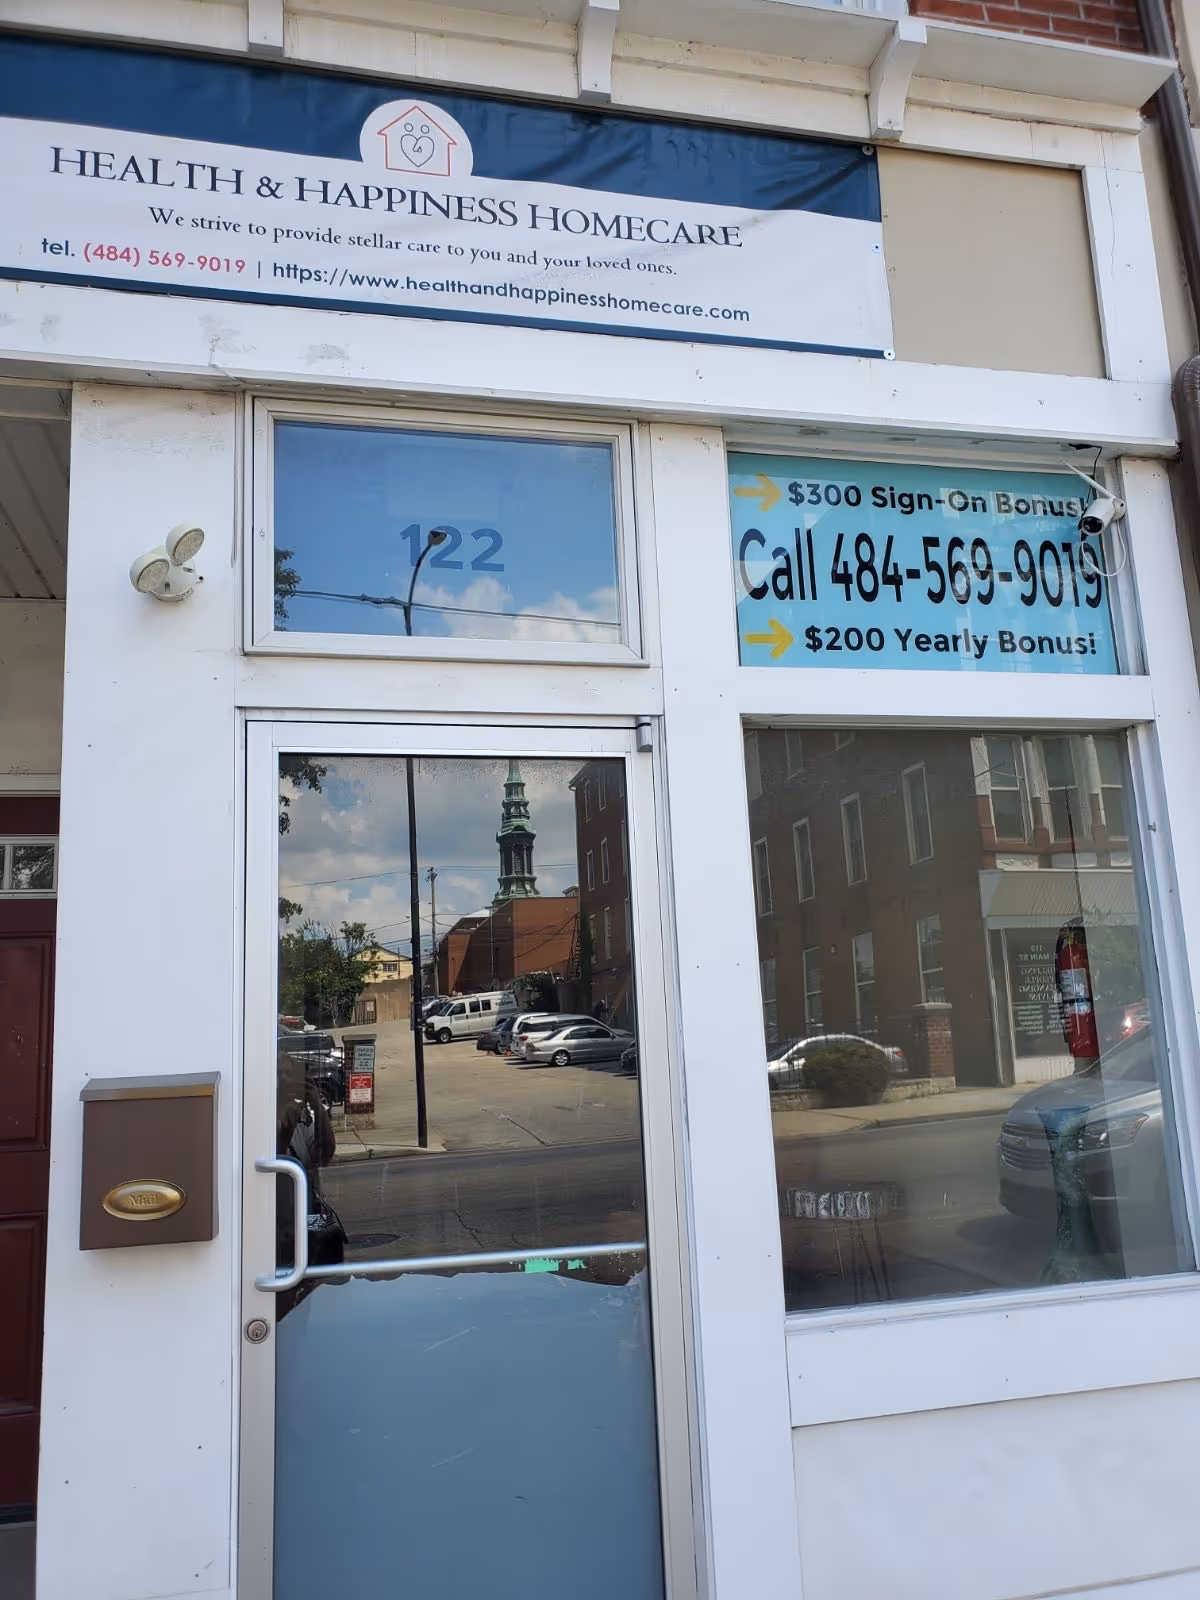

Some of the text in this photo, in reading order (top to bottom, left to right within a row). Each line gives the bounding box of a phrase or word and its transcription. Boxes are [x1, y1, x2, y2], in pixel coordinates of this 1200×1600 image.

[49, 146, 743, 248] HEALTH & HAPPINESS HOMECARE
[148, 206, 677, 276] We strive to provide stellar care to you and your loved ones.
[41, 238, 76, 258] tel.
[83, 241, 141, 268] (484)
[148, 249, 247, 275] 569-9019
[273, 262, 750, 322] https://www.healthandhappinesshomecare.com
[788, 481, 1085, 518] $300 Sign-On Bonus!
[400, 523, 505, 573] 122
[739, 527, 1102, 609] Call 484-569-9019
[805, 624, 1097, 660] $200 Yearly Bonus!
[129, 1193, 159, 1206] Mail
